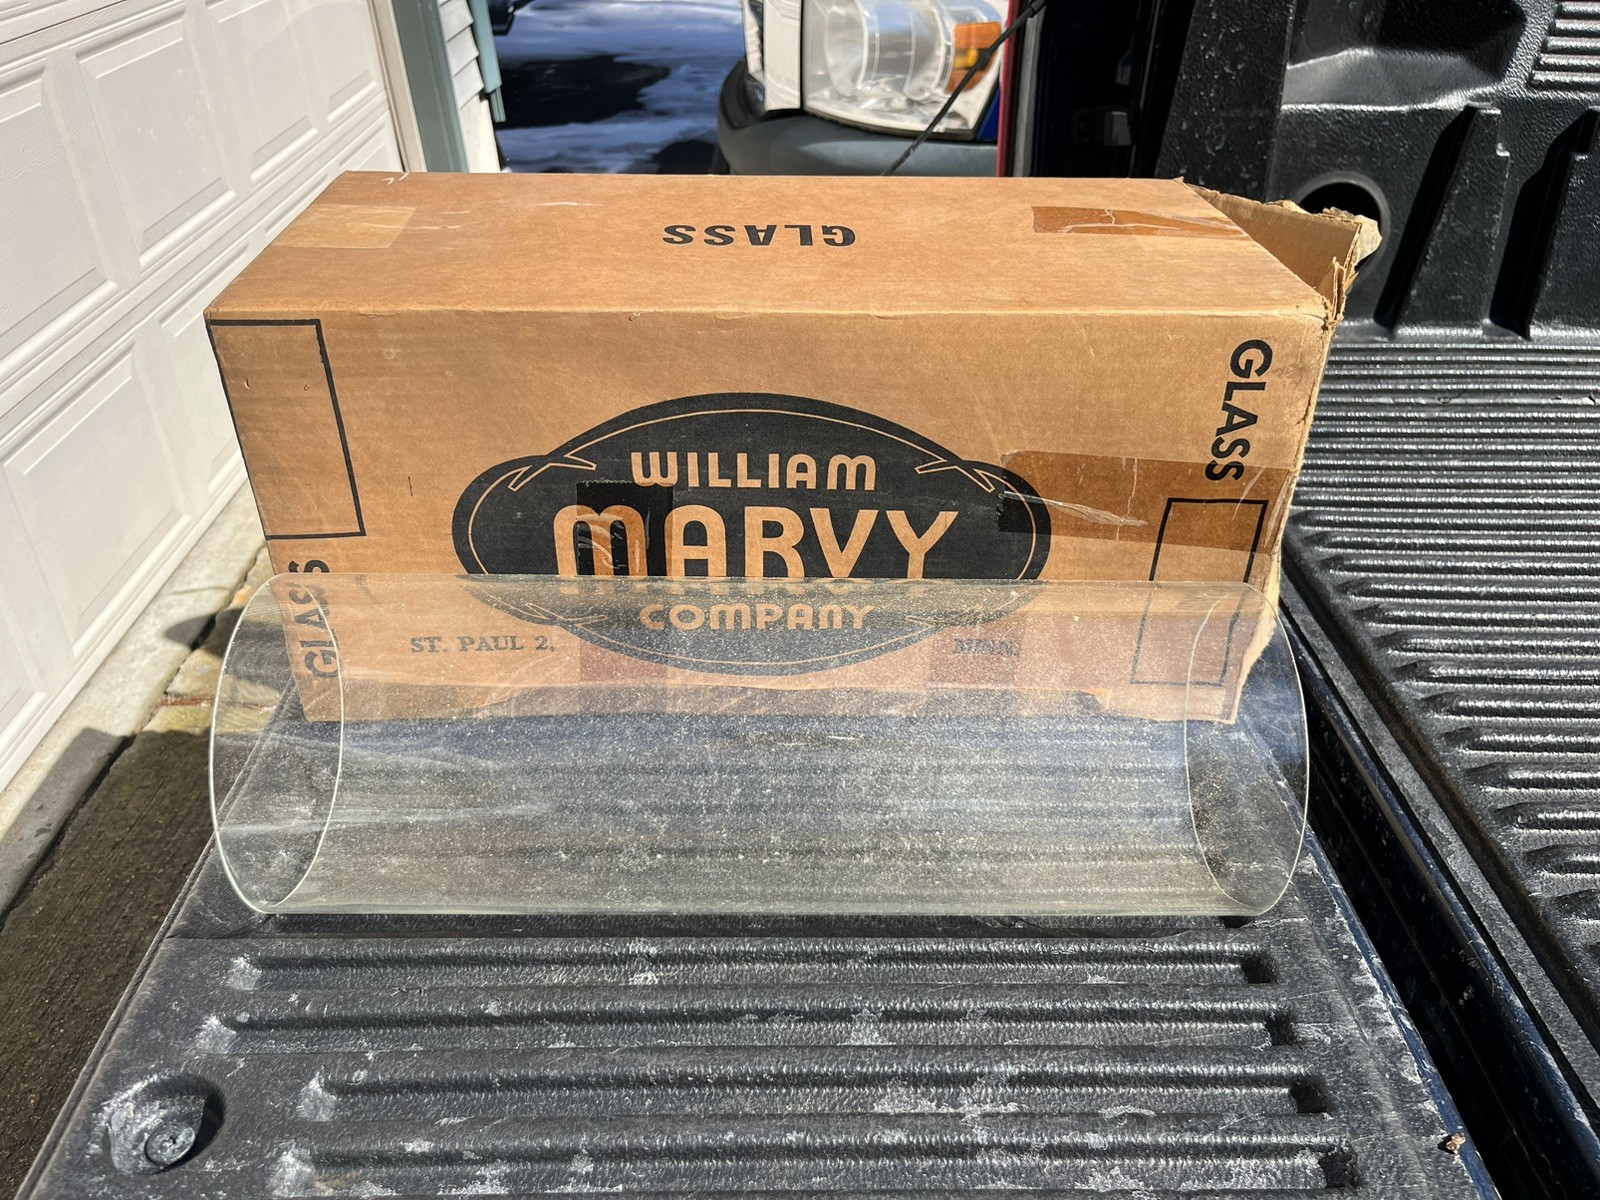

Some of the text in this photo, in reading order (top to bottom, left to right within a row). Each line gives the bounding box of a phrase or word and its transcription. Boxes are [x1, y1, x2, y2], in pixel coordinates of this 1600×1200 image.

[662, 224, 857, 247] GLASS
[1204, 339, 1273, 482] GLASS
[631, 451, 876, 491] WILLIAM
[552, 504, 959, 580] MARVY
[639, 603, 876, 631] COMPANY
[410, 635, 448, 653] ST.
[458, 634, 525, 652] PAUL
